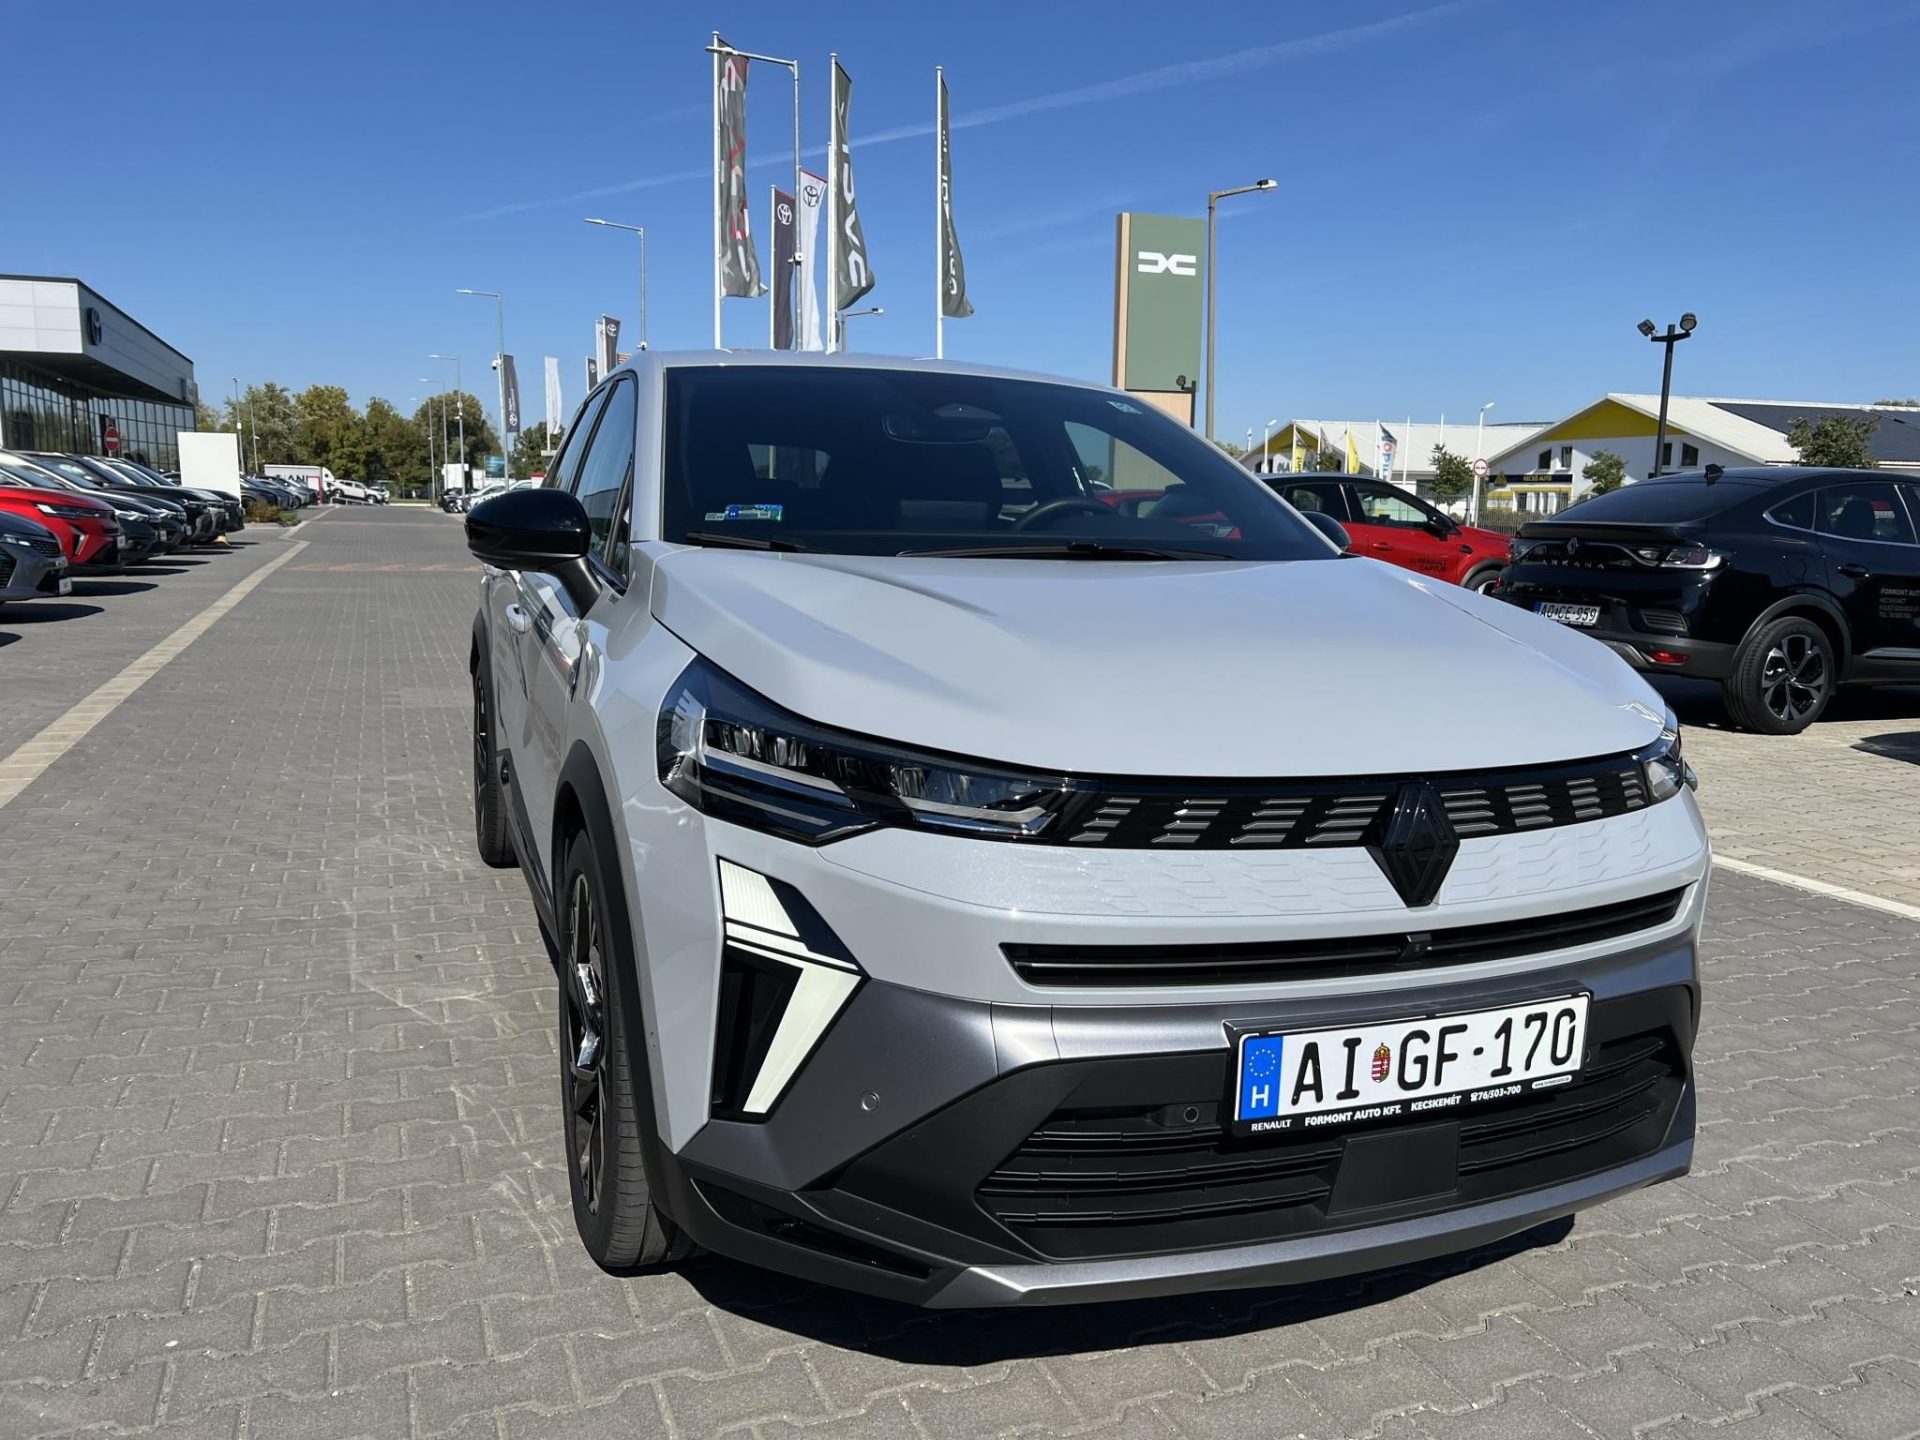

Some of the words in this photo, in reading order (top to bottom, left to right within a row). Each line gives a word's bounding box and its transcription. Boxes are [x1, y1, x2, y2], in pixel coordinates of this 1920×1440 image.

[1542, 560, 1605, 569] ARKANA
[1251, 1084, 1270, 1109] H
[1251, 1119, 1292, 1132] RENAULT
[1304, 1112, 1352, 1126] FORMONT
[1354, 1108, 1381, 1120] AUTO
[1383, 1105, 1401, 1116] KFT.
[1411, 1095, 1462, 1111] KECSKEMÉT
